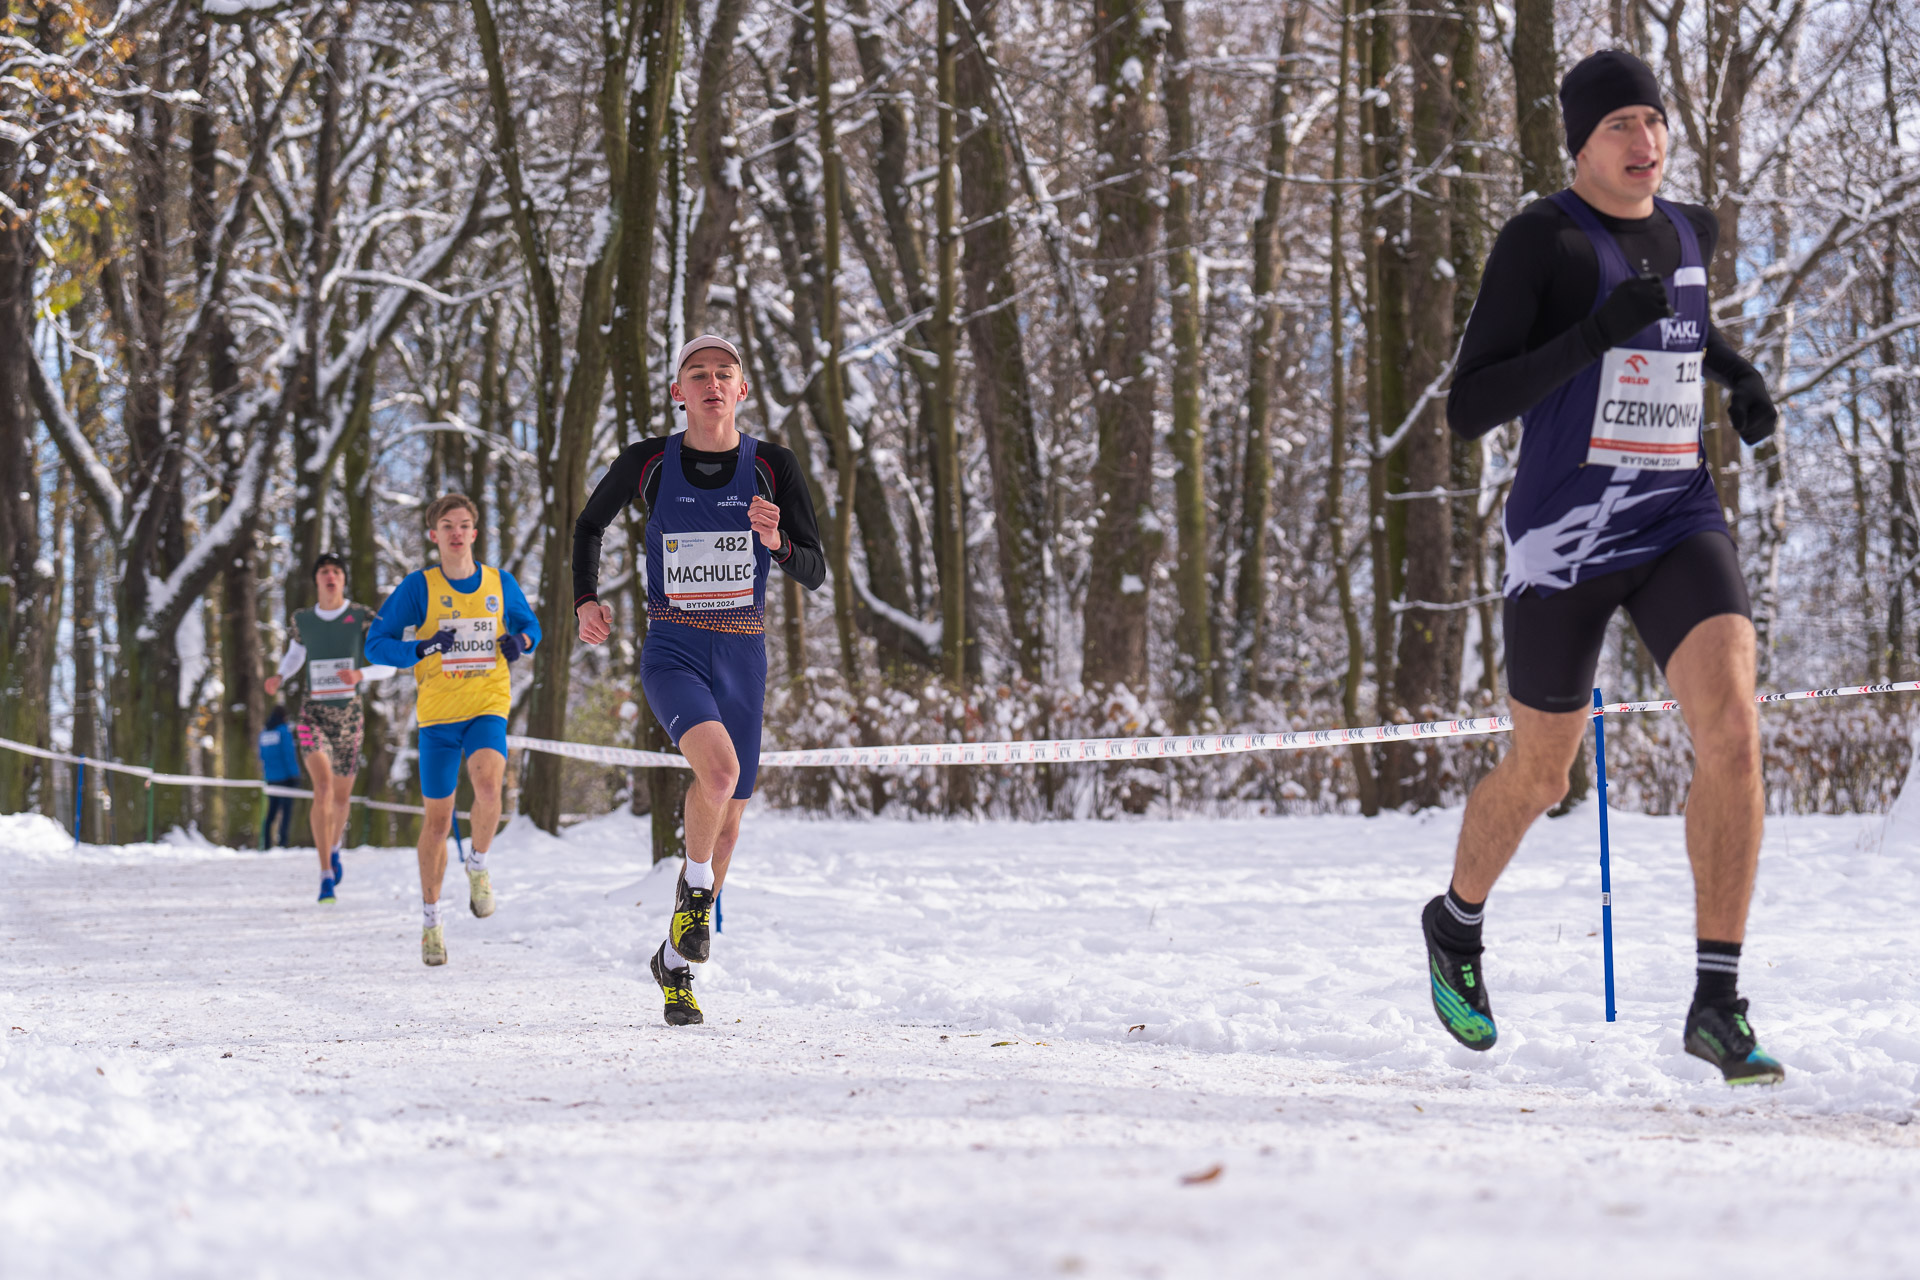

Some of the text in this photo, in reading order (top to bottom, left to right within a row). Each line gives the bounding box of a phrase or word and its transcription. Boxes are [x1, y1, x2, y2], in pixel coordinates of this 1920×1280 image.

[1667, 320, 1700, 338] MKL
[1618, 375, 1650, 385] ORLEN
[1621, 455, 1659, 467] BYTOM
[714, 536, 748, 552] 482
[667, 563, 751, 584] MACHULEC
[716, 600, 735, 608] 2024
[474, 621, 493, 632] 581
[449, 640, 494, 653] RUDŁO
